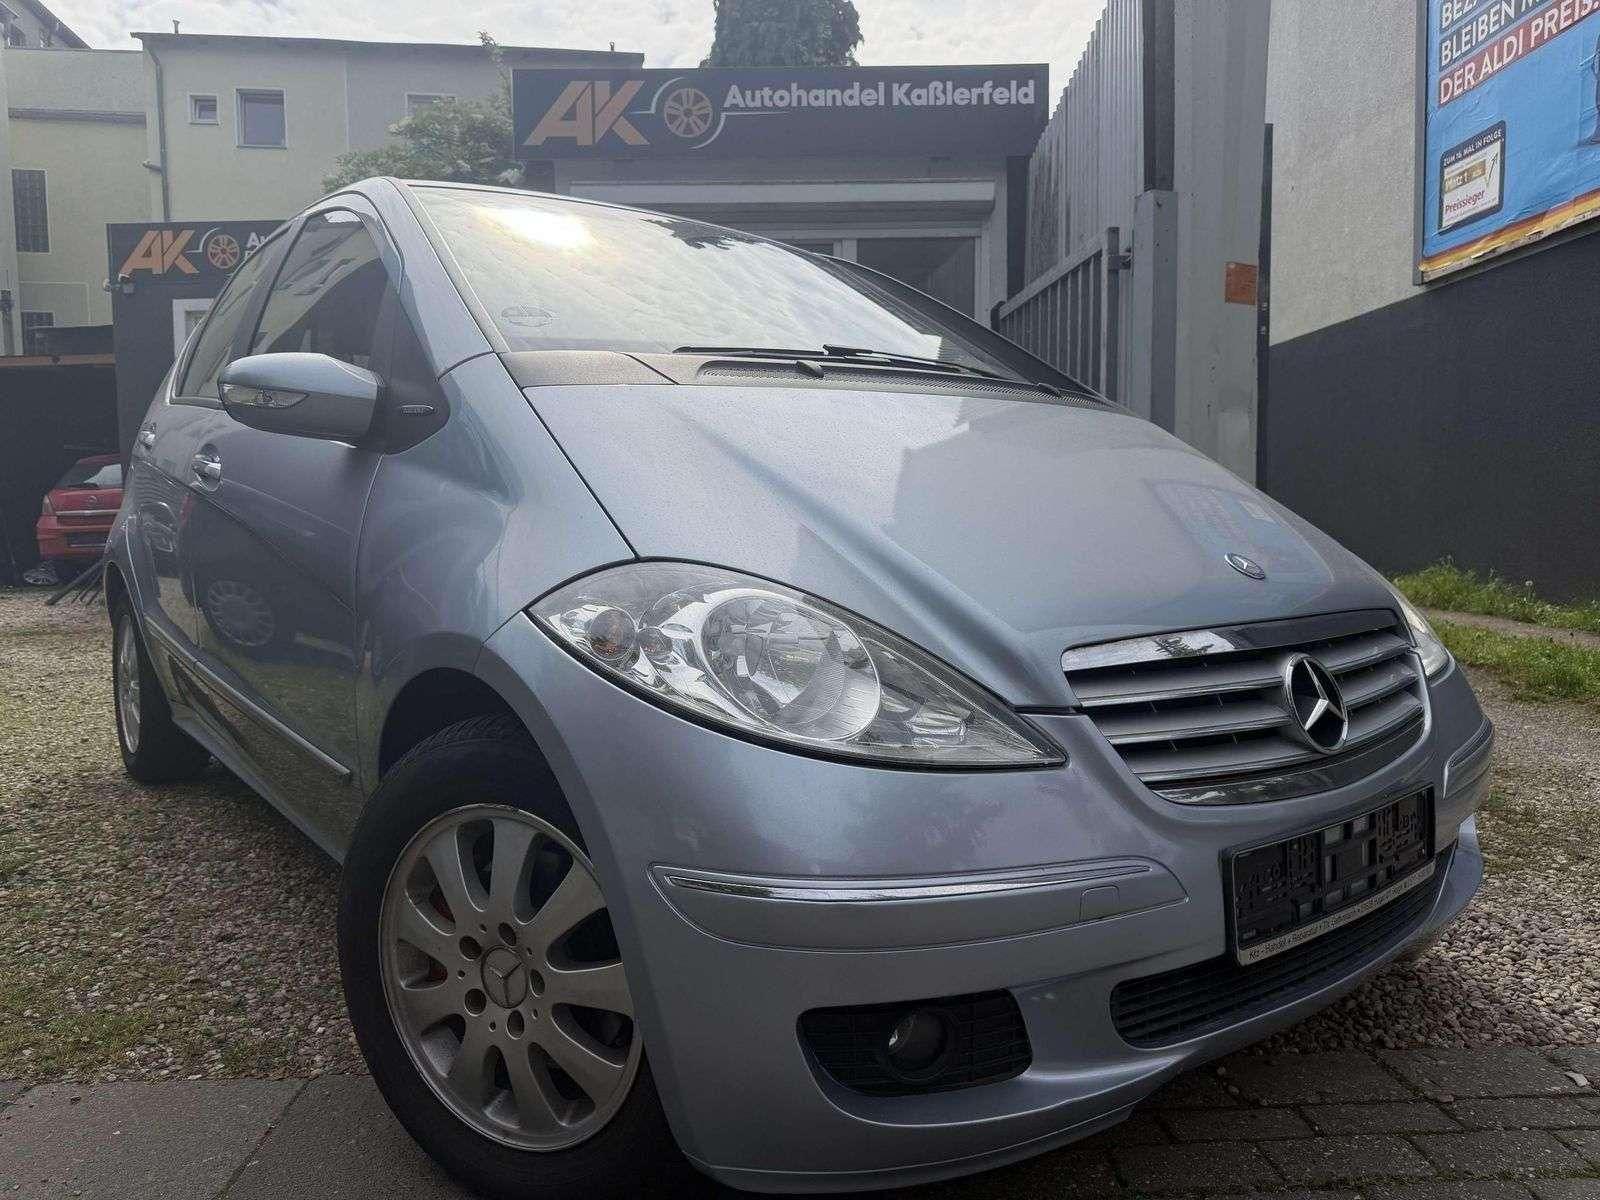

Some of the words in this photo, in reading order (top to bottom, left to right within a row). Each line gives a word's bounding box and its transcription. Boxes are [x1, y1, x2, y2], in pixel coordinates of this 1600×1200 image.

[1441, 0, 1515, 66] BLEIBEN
[1440, 62, 1476, 105] DER
[1479, 28, 1523, 80] ALDI
[522, 80, 649, 146] AK
[723, 81, 886, 109] Autohandel
[892, 80, 1035, 107] Kaßlerfeld
[1483, 129, 1502, 146] FOLGE
[1445, 189, 1485, 214] Preissieger
[119, 230, 200, 274] AK
